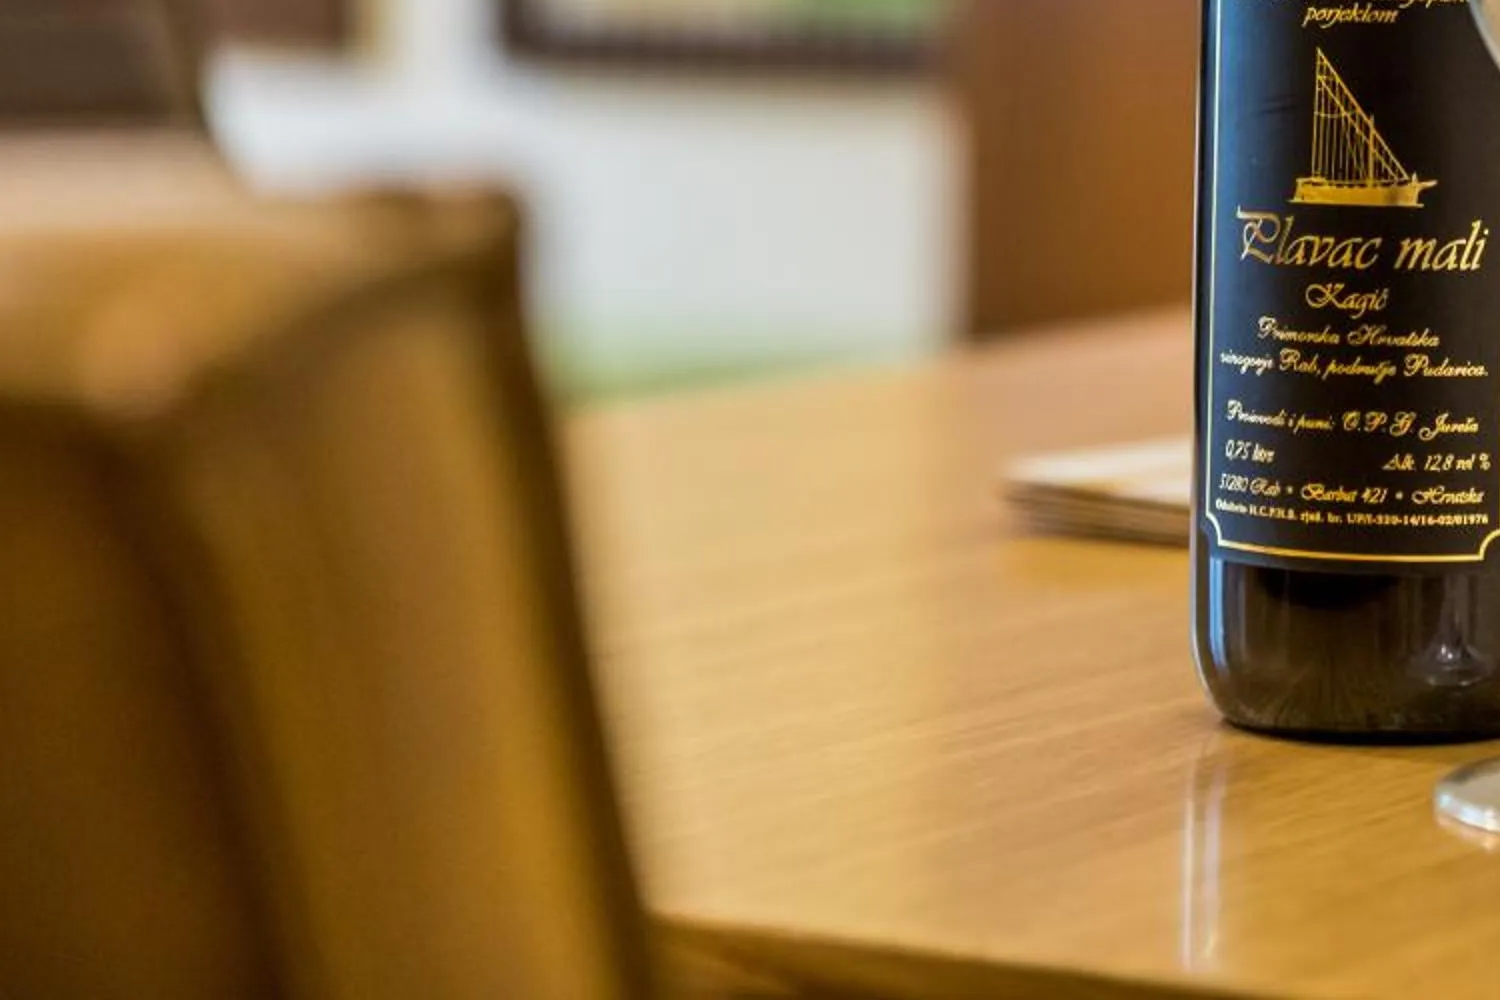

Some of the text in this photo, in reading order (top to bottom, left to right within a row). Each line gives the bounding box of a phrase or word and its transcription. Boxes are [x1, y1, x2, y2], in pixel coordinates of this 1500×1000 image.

[1236, 205, 1490, 272] Plavac mali
[1347, 323, 1441, 348] Hrvatska
[1479, 452, 1492, 472] %
